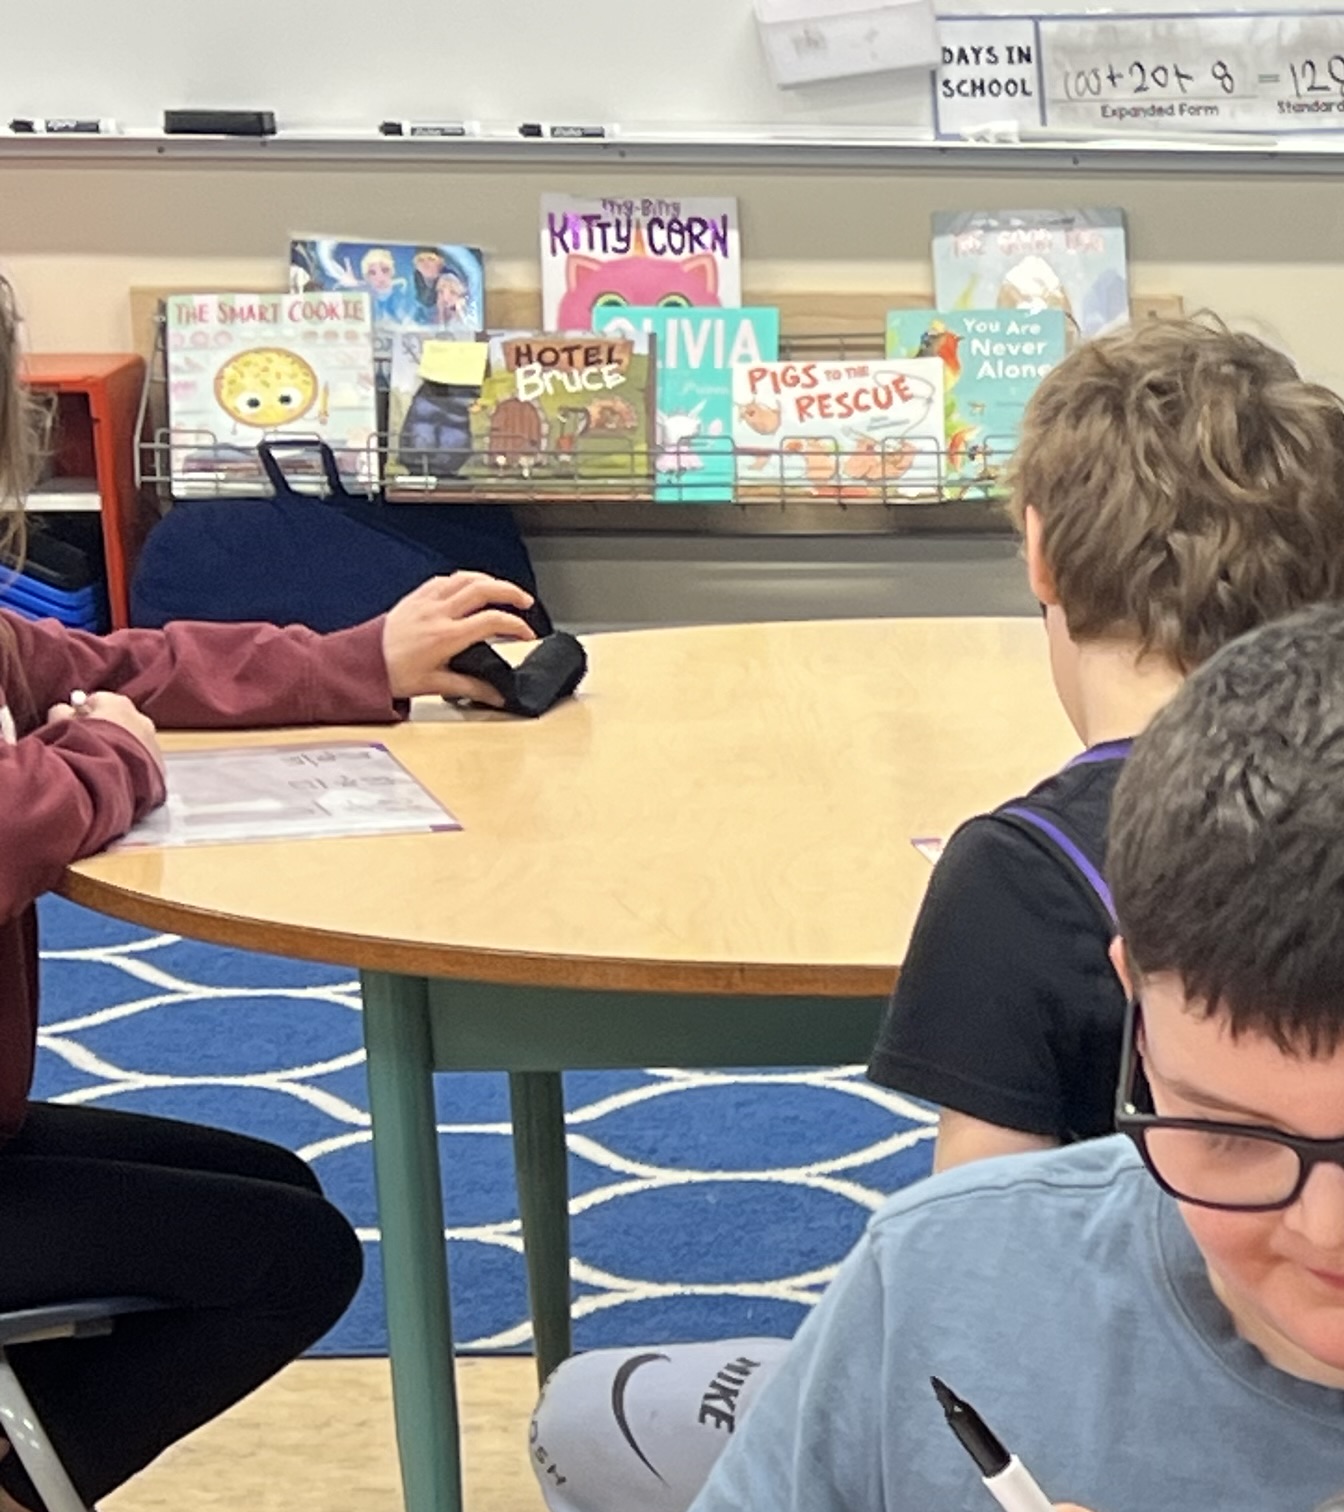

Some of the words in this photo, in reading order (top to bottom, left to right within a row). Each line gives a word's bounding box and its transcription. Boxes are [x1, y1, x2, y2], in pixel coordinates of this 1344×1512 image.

[941, 46, 999, 65] DAYS
[1006, 47, 1033, 64] IN
[941, 78, 1034, 98] SCHOOL
[1100, 103, 1176, 119] Expanded
[1178, 103, 1220, 118] Form
[647, 214, 728, 259] CORN
[175, 304, 209, 325] THE
[217, 303, 280, 325] SMART
[288, 301, 365, 323] COOKIE
[963, 318, 1001, 333] You
[1006, 320, 1041, 335] Are
[514, 343, 624, 369] HOTEL
[971, 338, 1047, 356] Never
[748, 364, 818, 395] PIGS
[794, 375, 914, 423] RESCUE
[698, 1356, 761, 1434] NIKE
